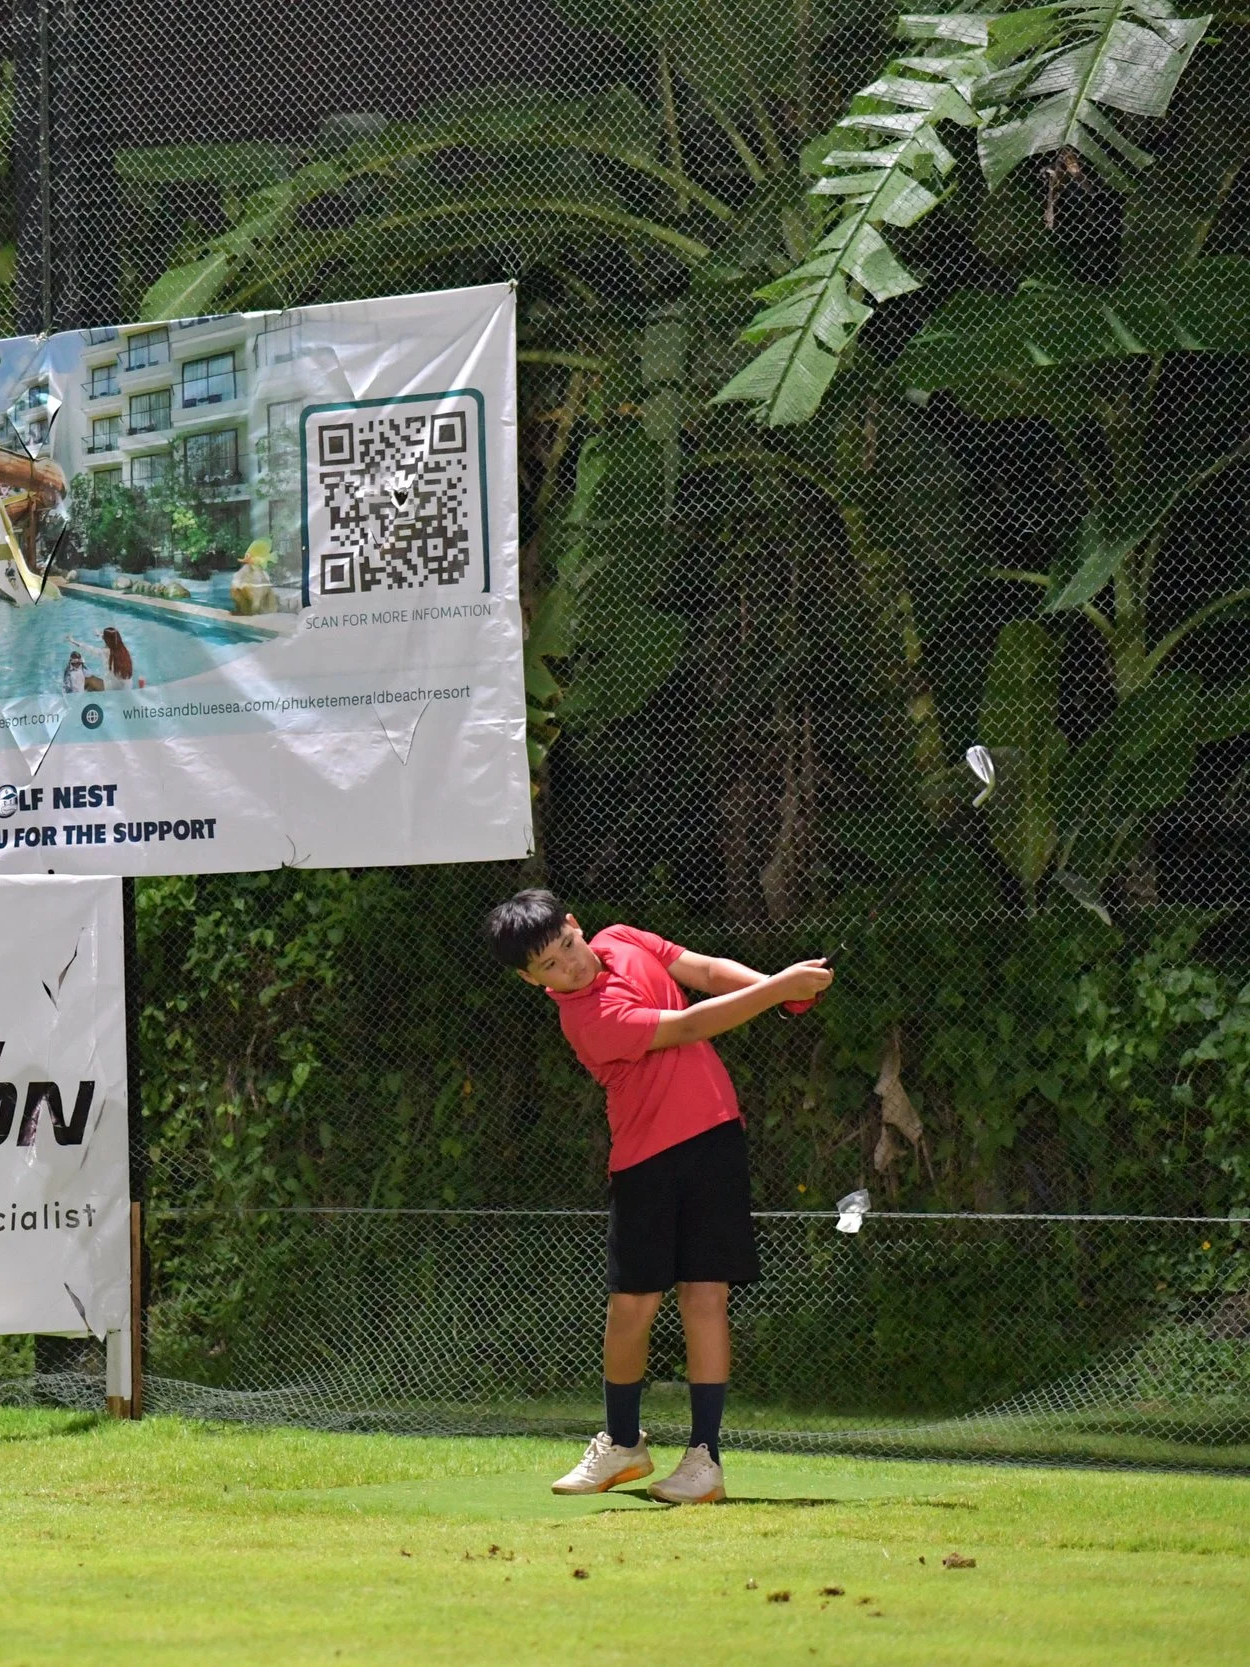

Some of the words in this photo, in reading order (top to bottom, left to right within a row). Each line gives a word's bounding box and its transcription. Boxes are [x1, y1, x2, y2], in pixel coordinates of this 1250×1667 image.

[305, 615, 339, 630] SCAN
[342, 613, 368, 627] FOR
[372, 610, 408, 625] MORE
[412, 603, 492, 621] INFOMATION
[123, 685, 471, 719] whitesandbluesea.com/phuketemeraldbeachresort
[52, 784, 118, 809] NEST
[14, 826, 57, 848] FOR
[63, 823, 107, 845] THE
[113, 818, 217, 843] SUPPORT
